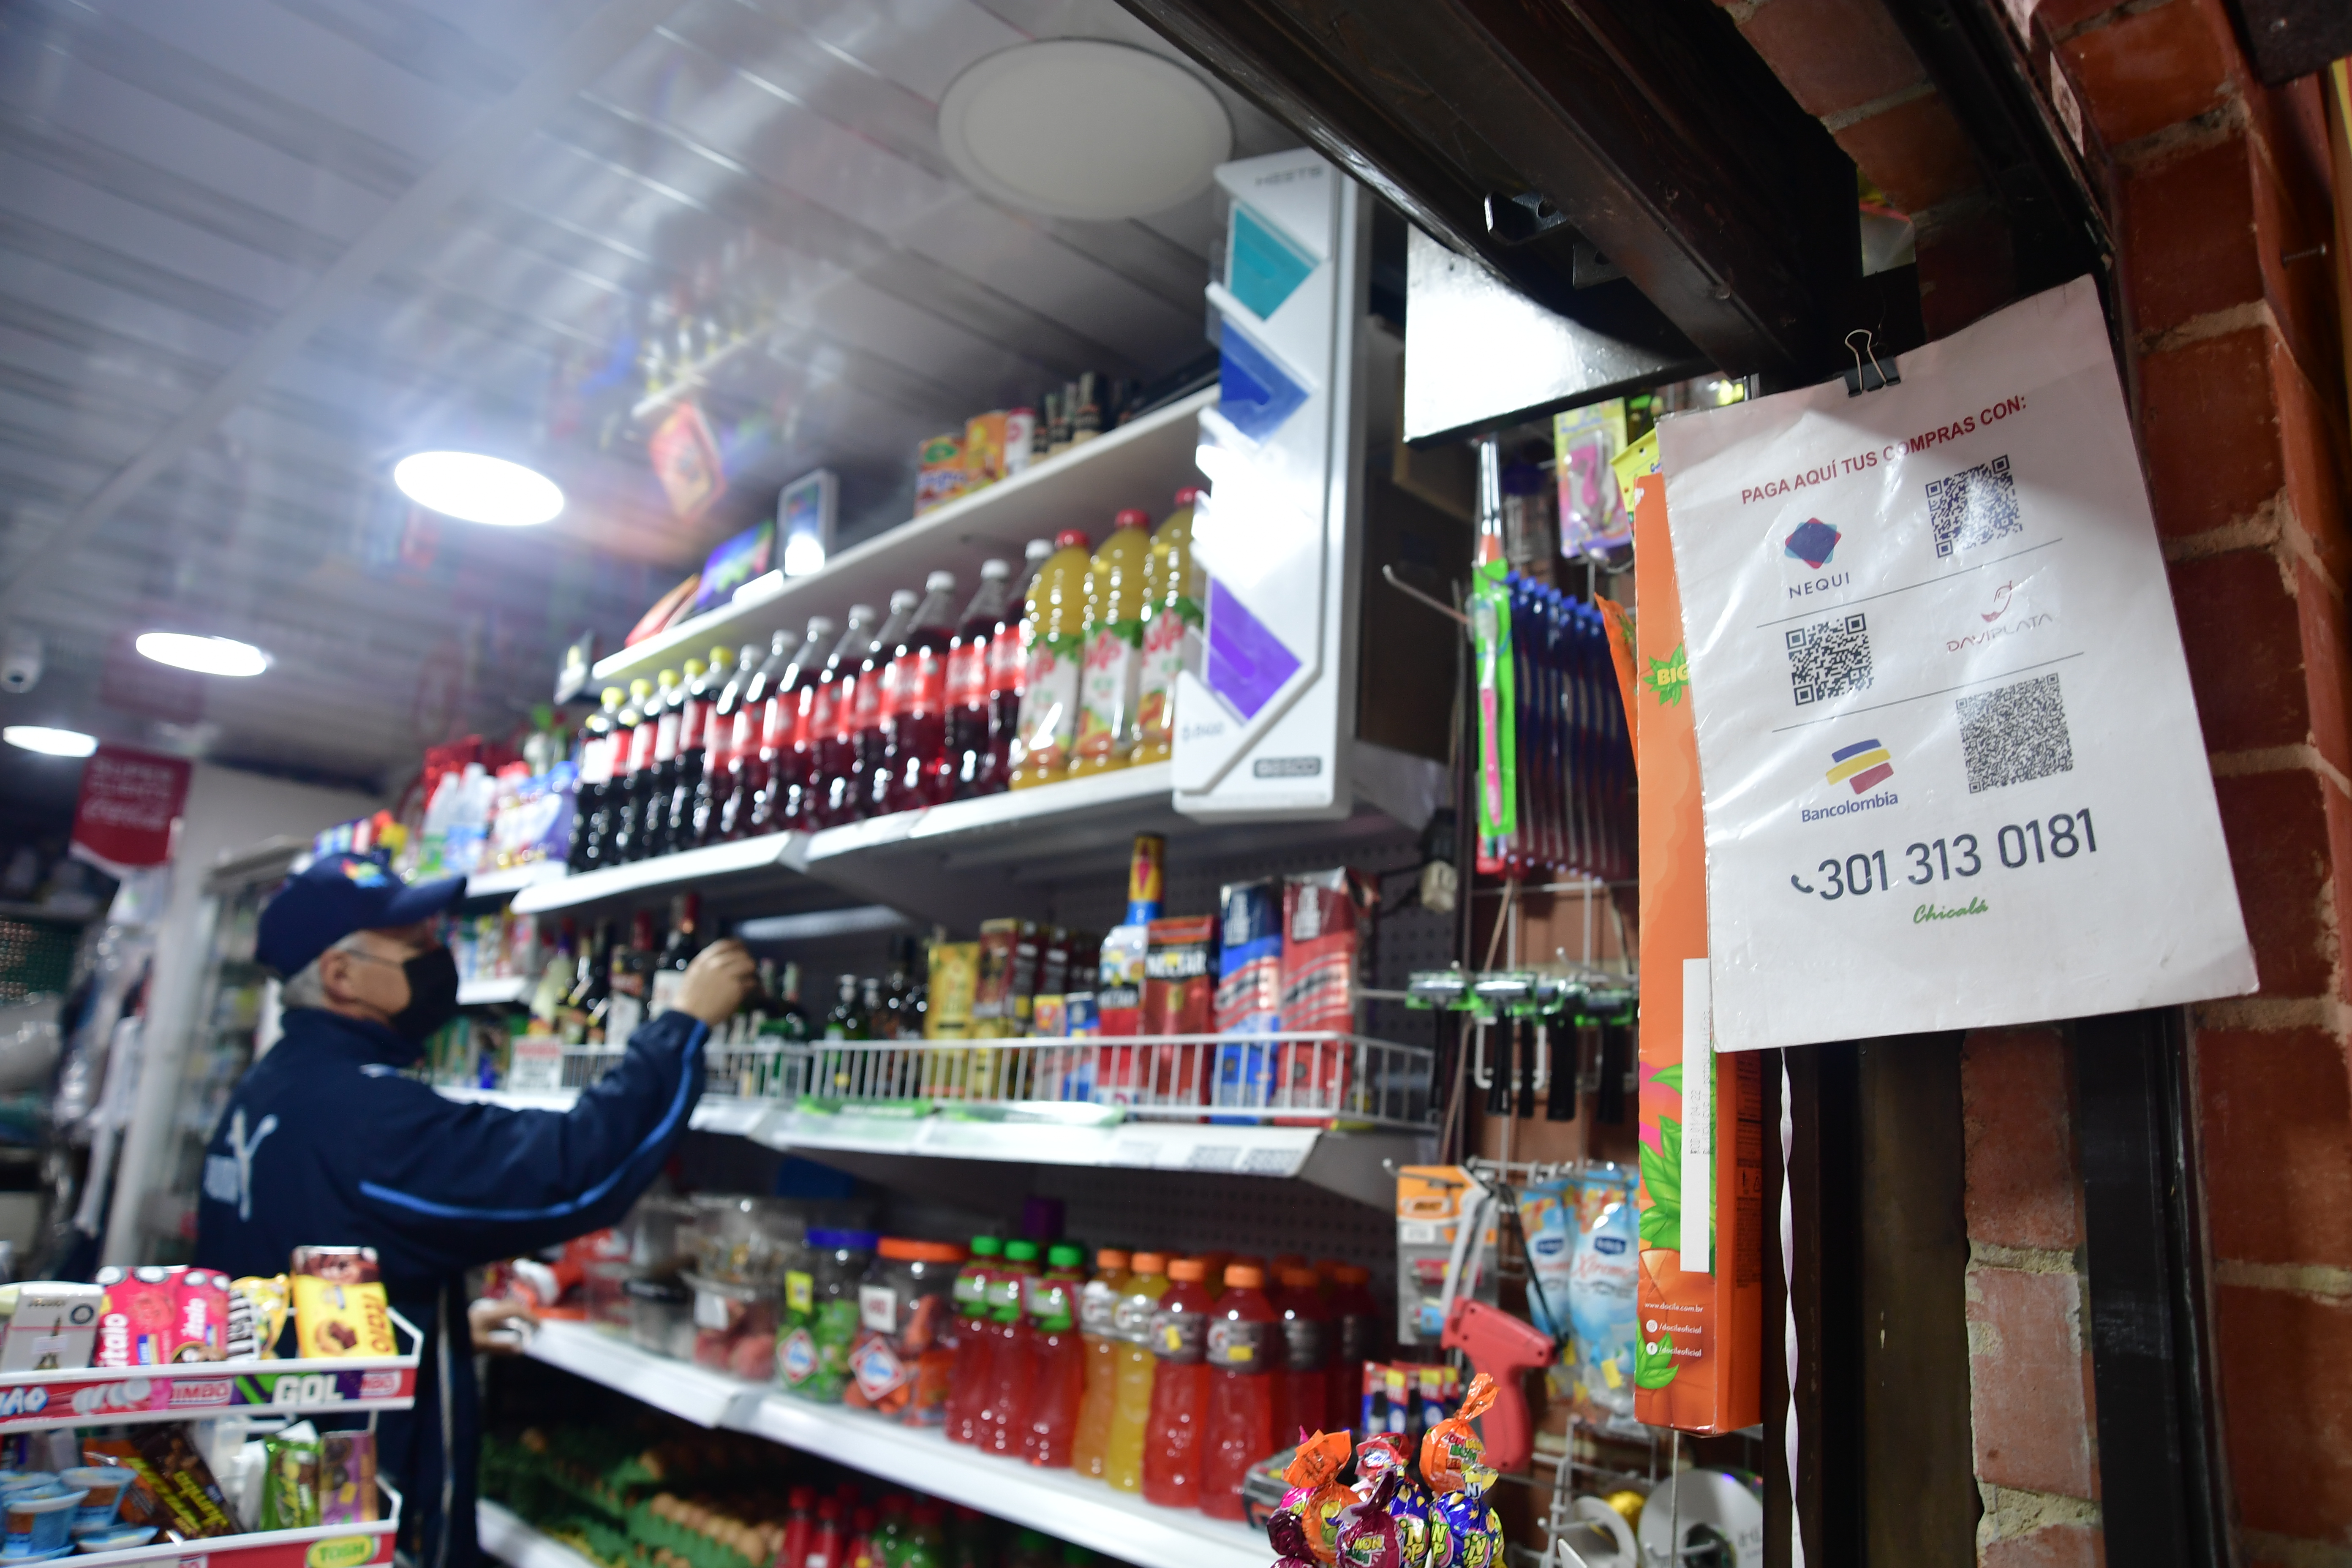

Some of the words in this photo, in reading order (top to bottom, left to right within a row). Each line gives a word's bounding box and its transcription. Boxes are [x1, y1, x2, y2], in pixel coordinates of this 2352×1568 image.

[1742, 478, 1791, 504] PAGA
[1794, 459, 1838, 491] AQUÍ
[1841, 451, 1878, 475] TUS
[1883, 416, 1976, 461] COMPRAS
[1980, 394, 2027, 426] CON:
[1788, 572, 1850, 599] NEQUI
[1657, 667, 1689, 686] BIG
[1801, 791, 1899, 823] Bancolombia
[1818, 849, 1889, 901] 301
[1905, 833, 1982, 886] 313
[1997, 807, 2098, 869] 0181
[1913, 896, 1988, 924] Chicalá
[1644, 1301, 1704, 1313] www.docile.com.br
[272, 1375, 344, 1405] GOL
